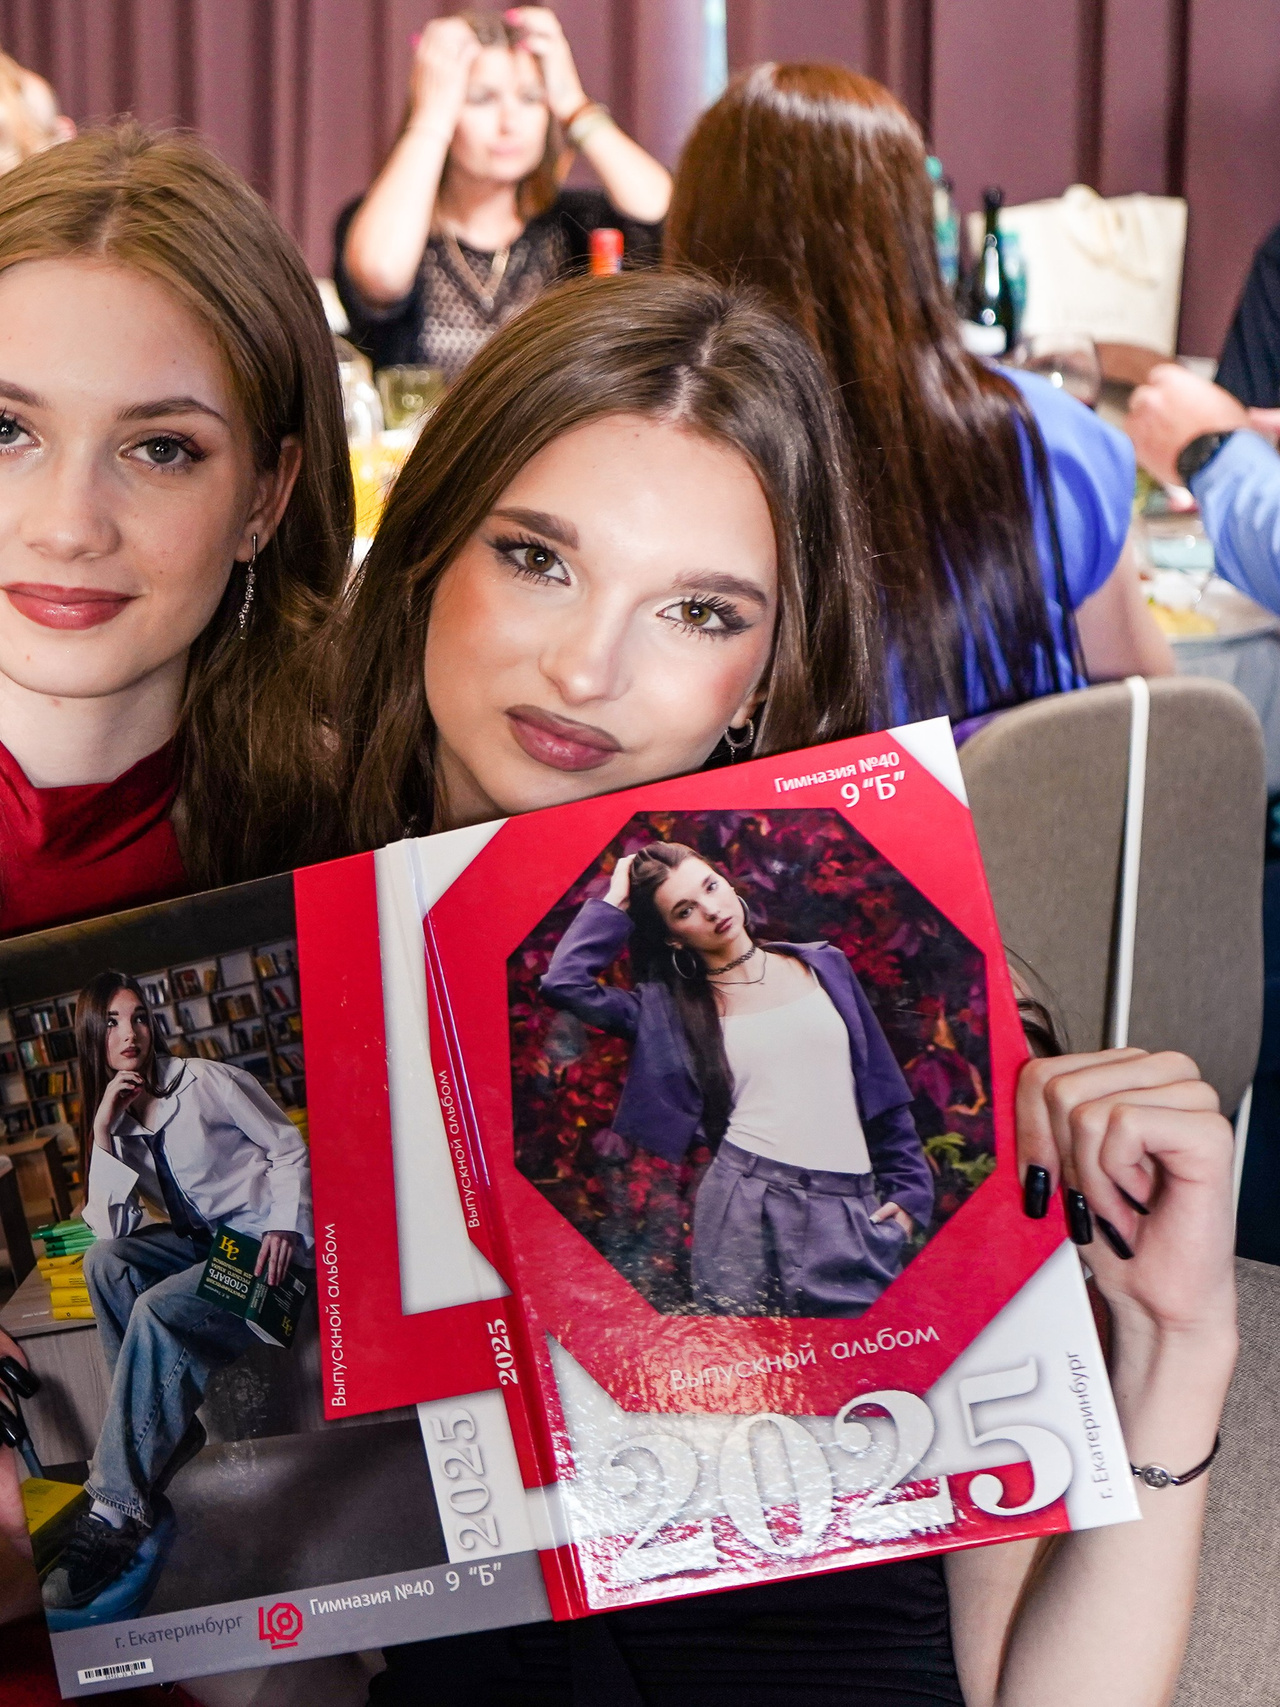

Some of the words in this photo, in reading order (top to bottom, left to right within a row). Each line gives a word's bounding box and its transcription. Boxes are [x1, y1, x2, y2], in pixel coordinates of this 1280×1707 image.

[774, 764, 857, 793] Гимназия
[858, 751, 900, 773] №40
[840, 782, 860, 808] 9
[437, 1069, 461, 1136] альбом
[448, 1138, 481, 1228] Выпускной
[209, 1268, 249, 1294] СЛОВАРЬ
[321, 1222, 341, 1298] альбом
[330, 1303, 349, 1408] Выпускной
[485, 1318, 518, 1386] 2025
[670, 1343, 818, 1391] Выпускной
[831, 1325, 940, 1361] альбом
[1066, 1351, 1110, 1484] Екатеринбург
[430, 1407, 501, 1552] 2025
[602, 1356, 1073, 1583] 2025
[309, 1590, 393, 1616] Гимназия
[394, 1579, 435, 1601] №40
[445, 1570, 460, 1592] 9
[129, 1614, 244, 1647] Екатеринбург
